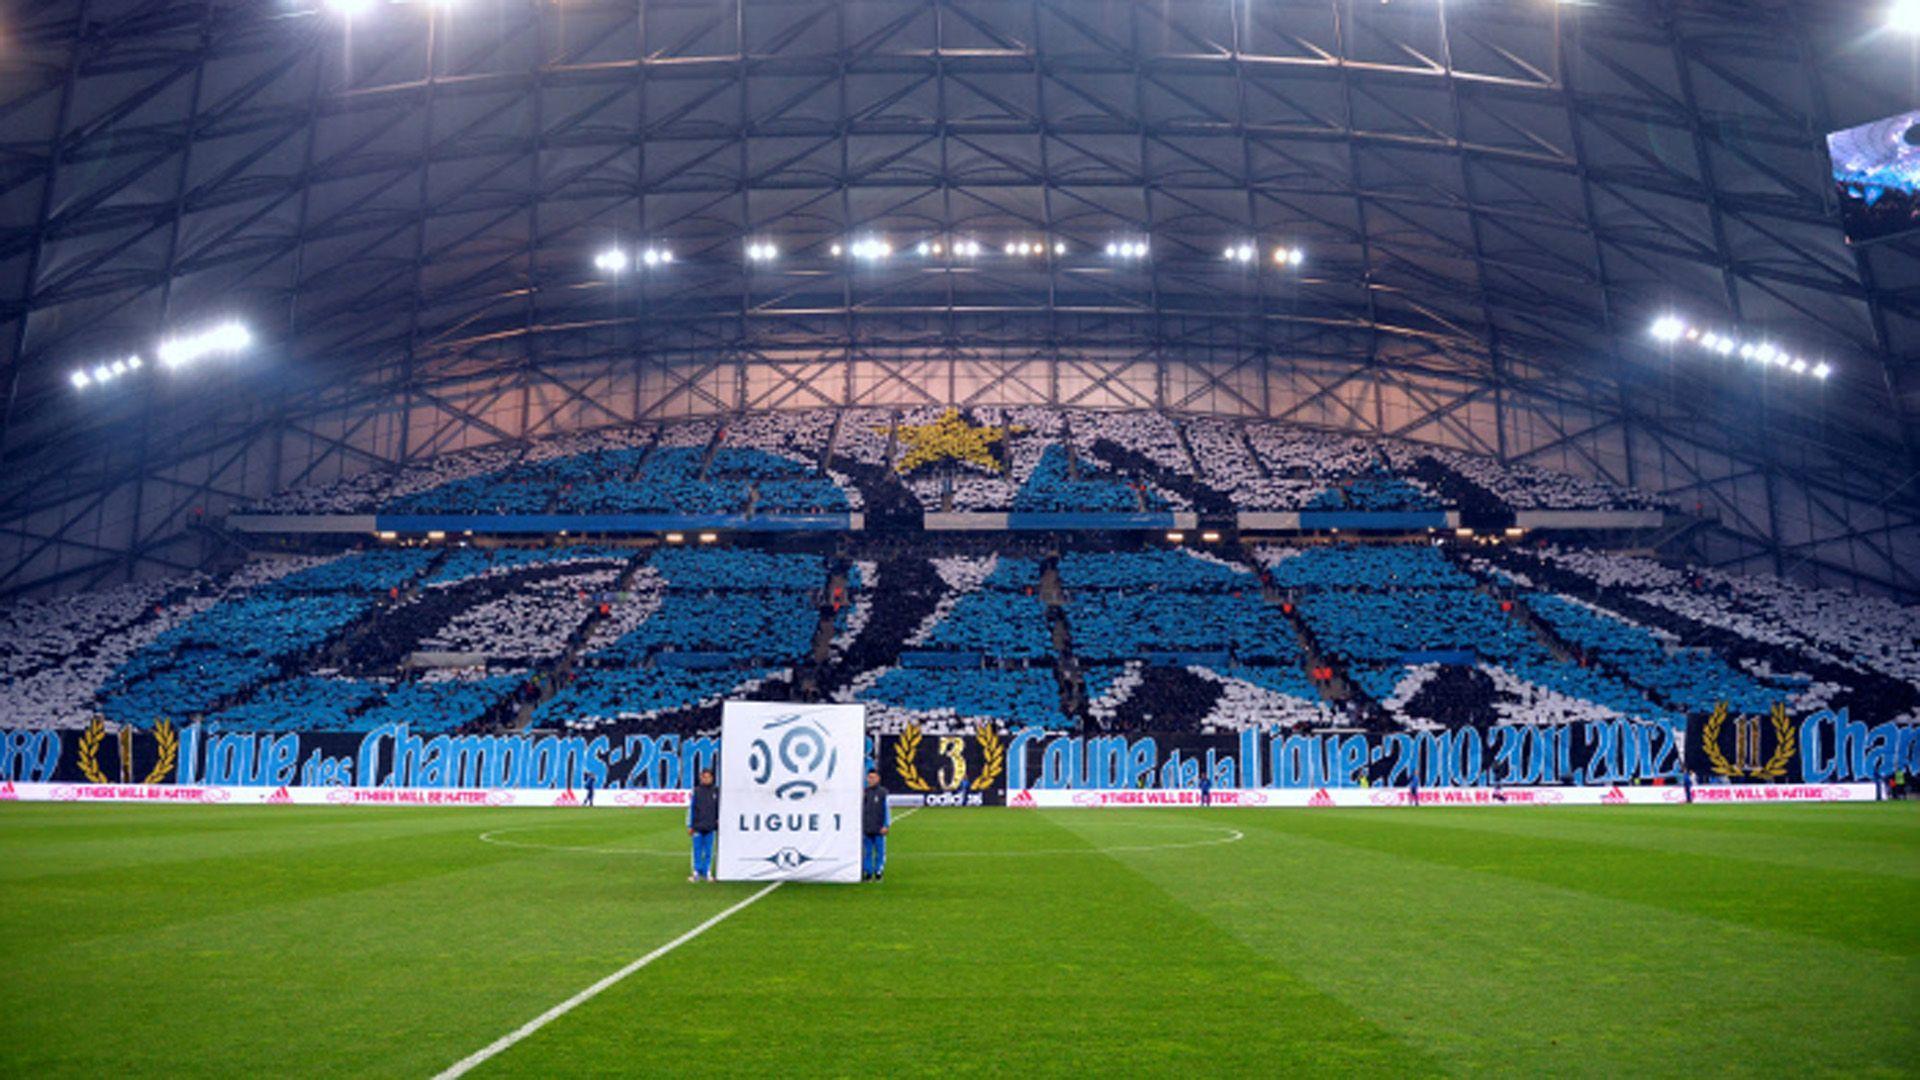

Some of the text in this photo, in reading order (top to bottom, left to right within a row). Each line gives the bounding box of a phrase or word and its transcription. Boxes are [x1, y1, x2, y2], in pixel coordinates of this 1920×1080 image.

[0, 729, 61, 783] 89
[302, 747, 354, 787] des
[938, 736, 967, 790] 3
[1007, 726, 1158, 789] Coupe
[1161, 749, 1200, 789] de
[1206, 748, 1236, 789] la
[1733, 713, 1763, 771] 11
[739, 813, 841, 832] LIGUE 1
[1147, 792, 1176, 804] WILL
[1179, 792, 1193, 804] BE
